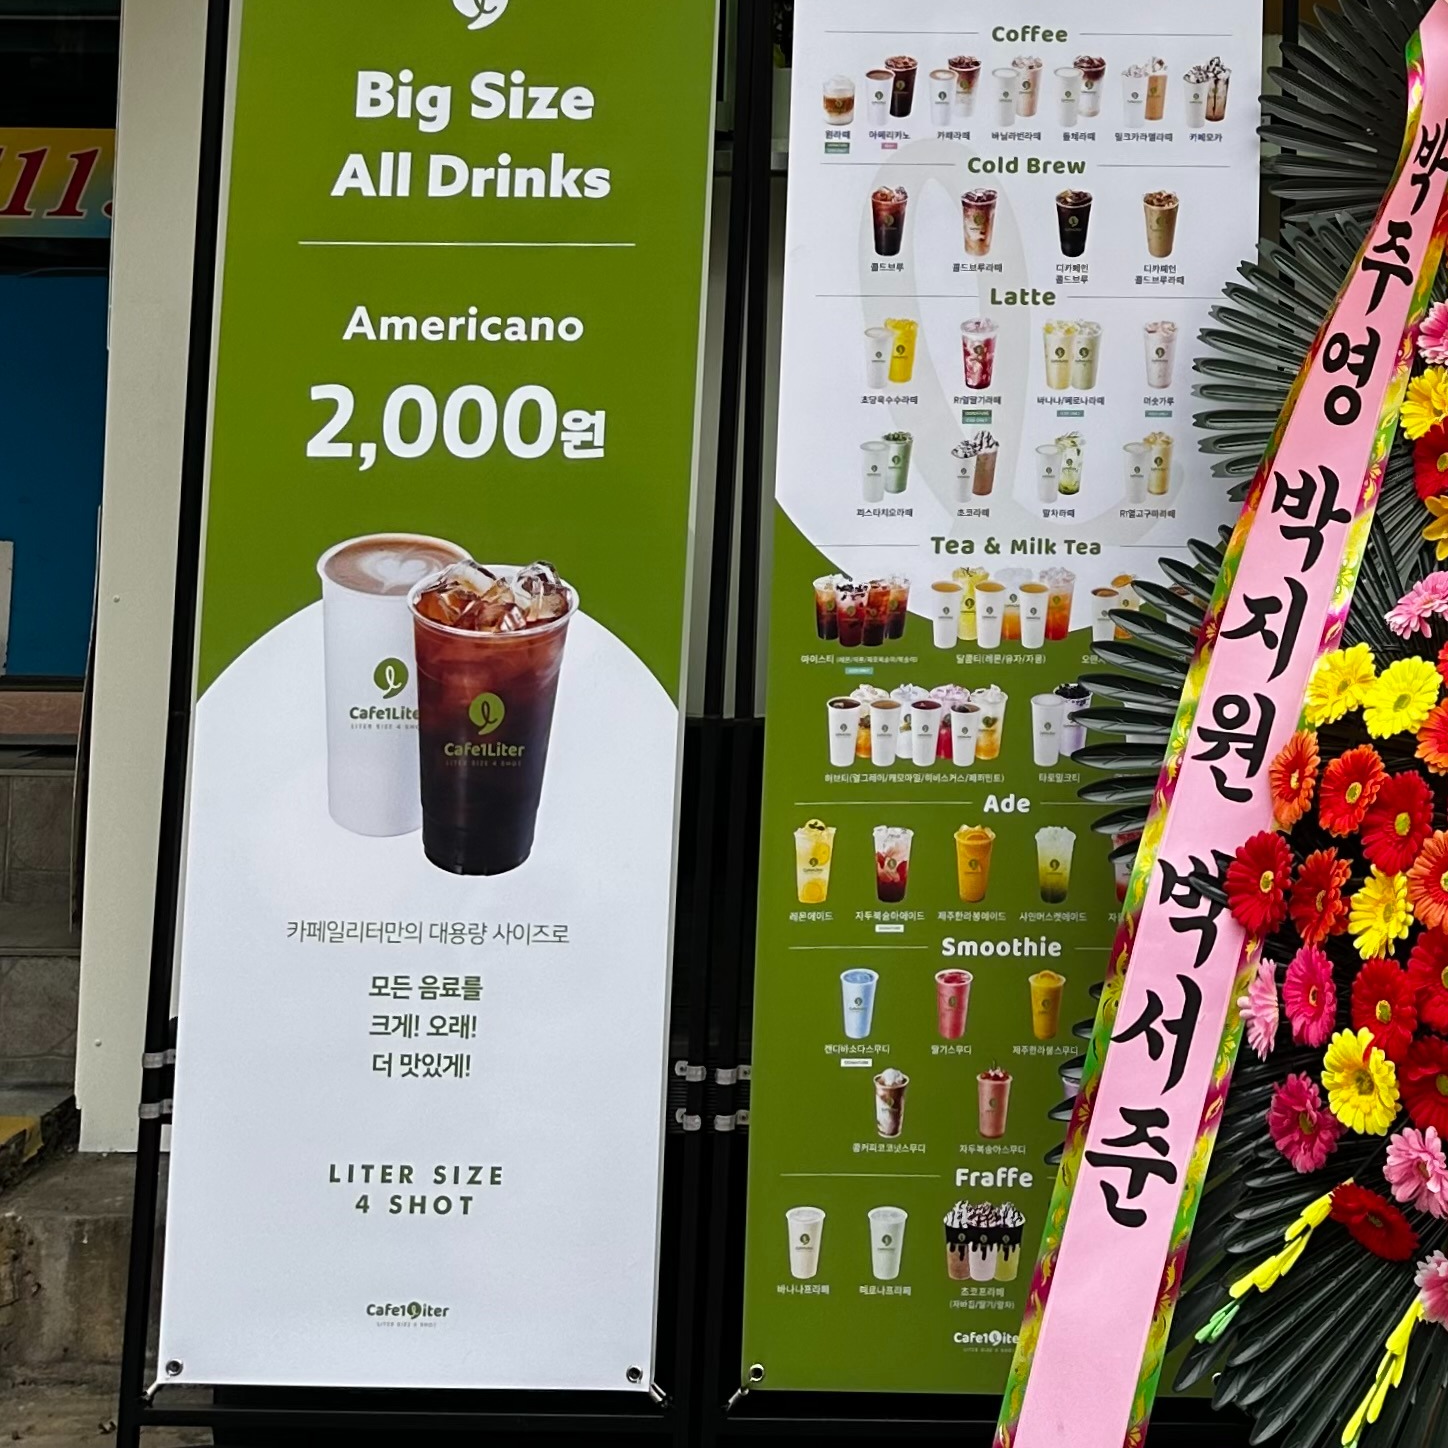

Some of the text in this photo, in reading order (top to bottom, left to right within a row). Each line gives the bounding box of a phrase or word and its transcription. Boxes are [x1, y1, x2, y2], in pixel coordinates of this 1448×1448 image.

[991, 25, 1069, 43] Coffee
[355, 69, 595, 132] Big Size
[330, 151, 611, 198] All Drinks
[967, 156, 1086, 175] Cold Brew
[989, 288, 1057, 306] Latte
[342, 306, 585, 342] Americano
[306, 384, 606, 472] 2,000원
[930, 536, 1102, 555] Tea & Milk Tea
[1192, 464, 1352, 804] 박지원
[444, 742, 525, 757] Cafe1Liter
[983, 794, 1031, 814] Ade
[286, 920, 570, 946] 카페일리터만의 대용량 사이즈로
[941, 936, 1062, 957] Smoothie
[368, 975, 483, 1001] 모든 음료를
[369, 1013, 477, 1040] 크게! 오래!
[1084, 849, 1236, 1228] 박서준
[372, 1052, 471, 1079] 더 맛있게!
[329, 1163, 503, 1186] LITER SIZE
[955, 1167, 1034, 1188] Fraffe
[355, 1194, 473, 1215] 4 SHOT
